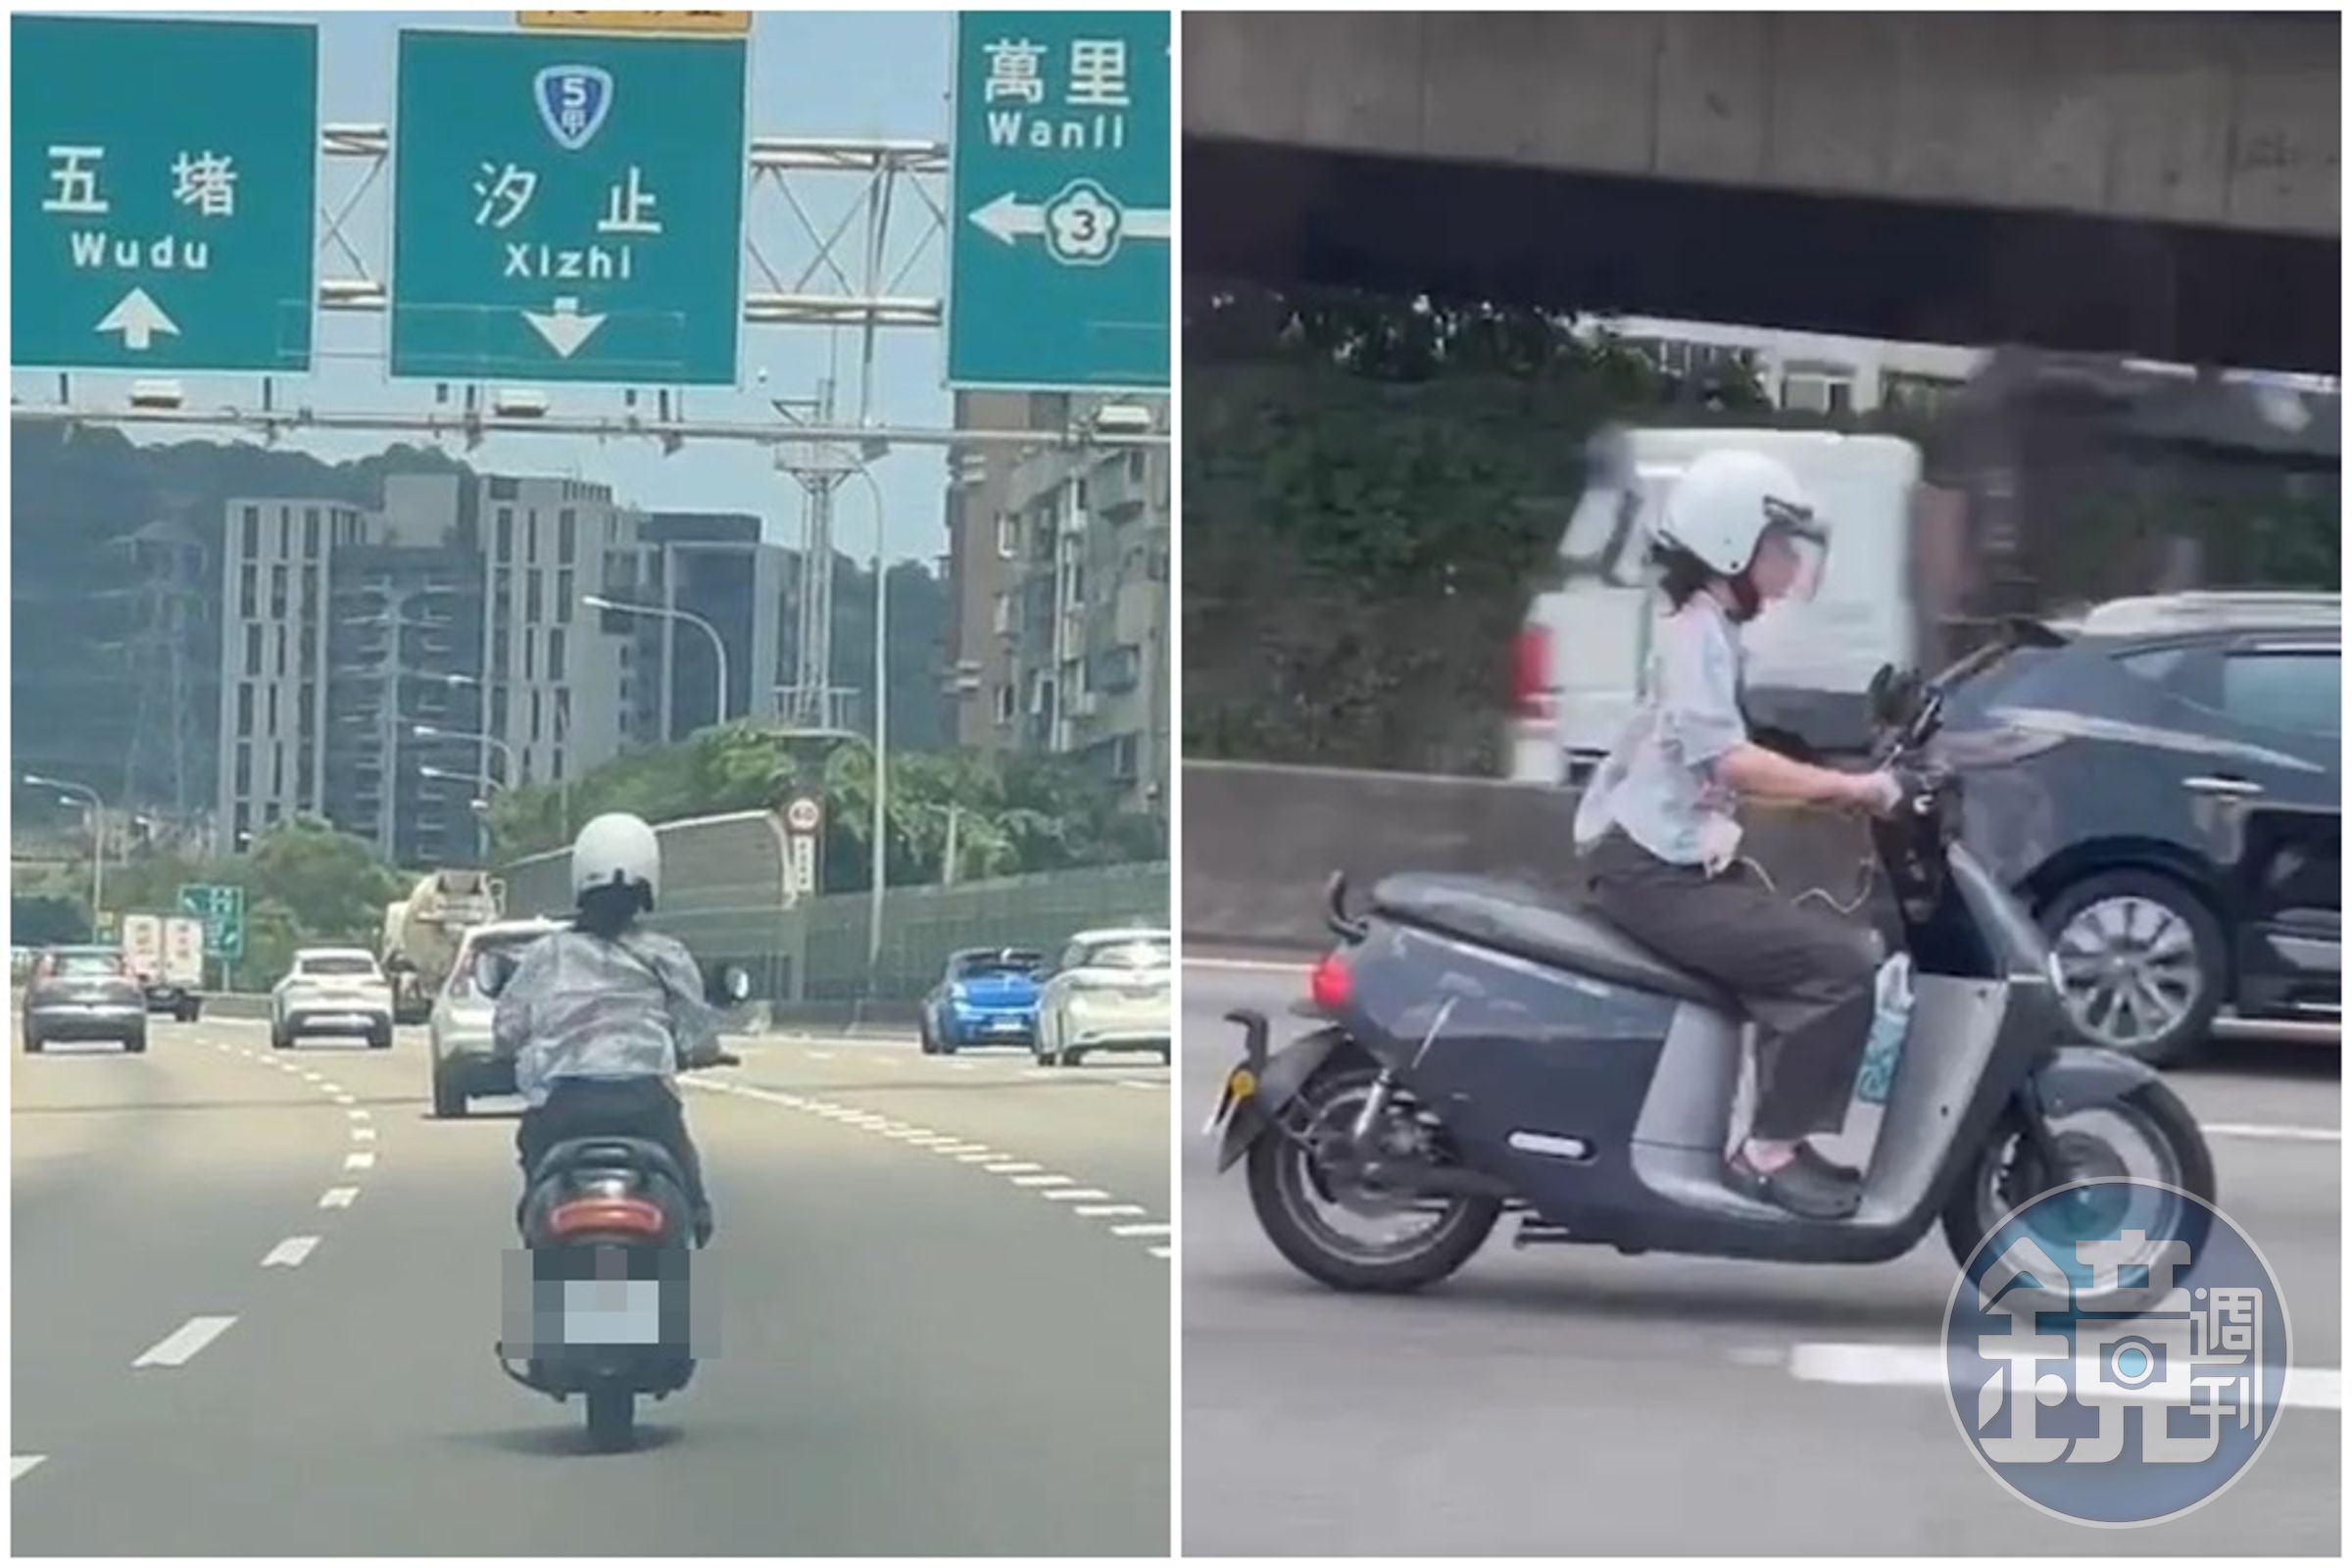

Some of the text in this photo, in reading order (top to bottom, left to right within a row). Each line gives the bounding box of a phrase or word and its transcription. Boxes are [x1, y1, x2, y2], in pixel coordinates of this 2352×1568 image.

[983, 37, 1130, 106] 萬里
[562, 76, 587, 107] 5
[42, 146, 237, 216] 五堵
[473, 162, 662, 233] 汐止
[1070, 209, 1097, 242] 3
[72, 231, 208, 270] Wudu
[504, 243, 631, 279] Xizhi
